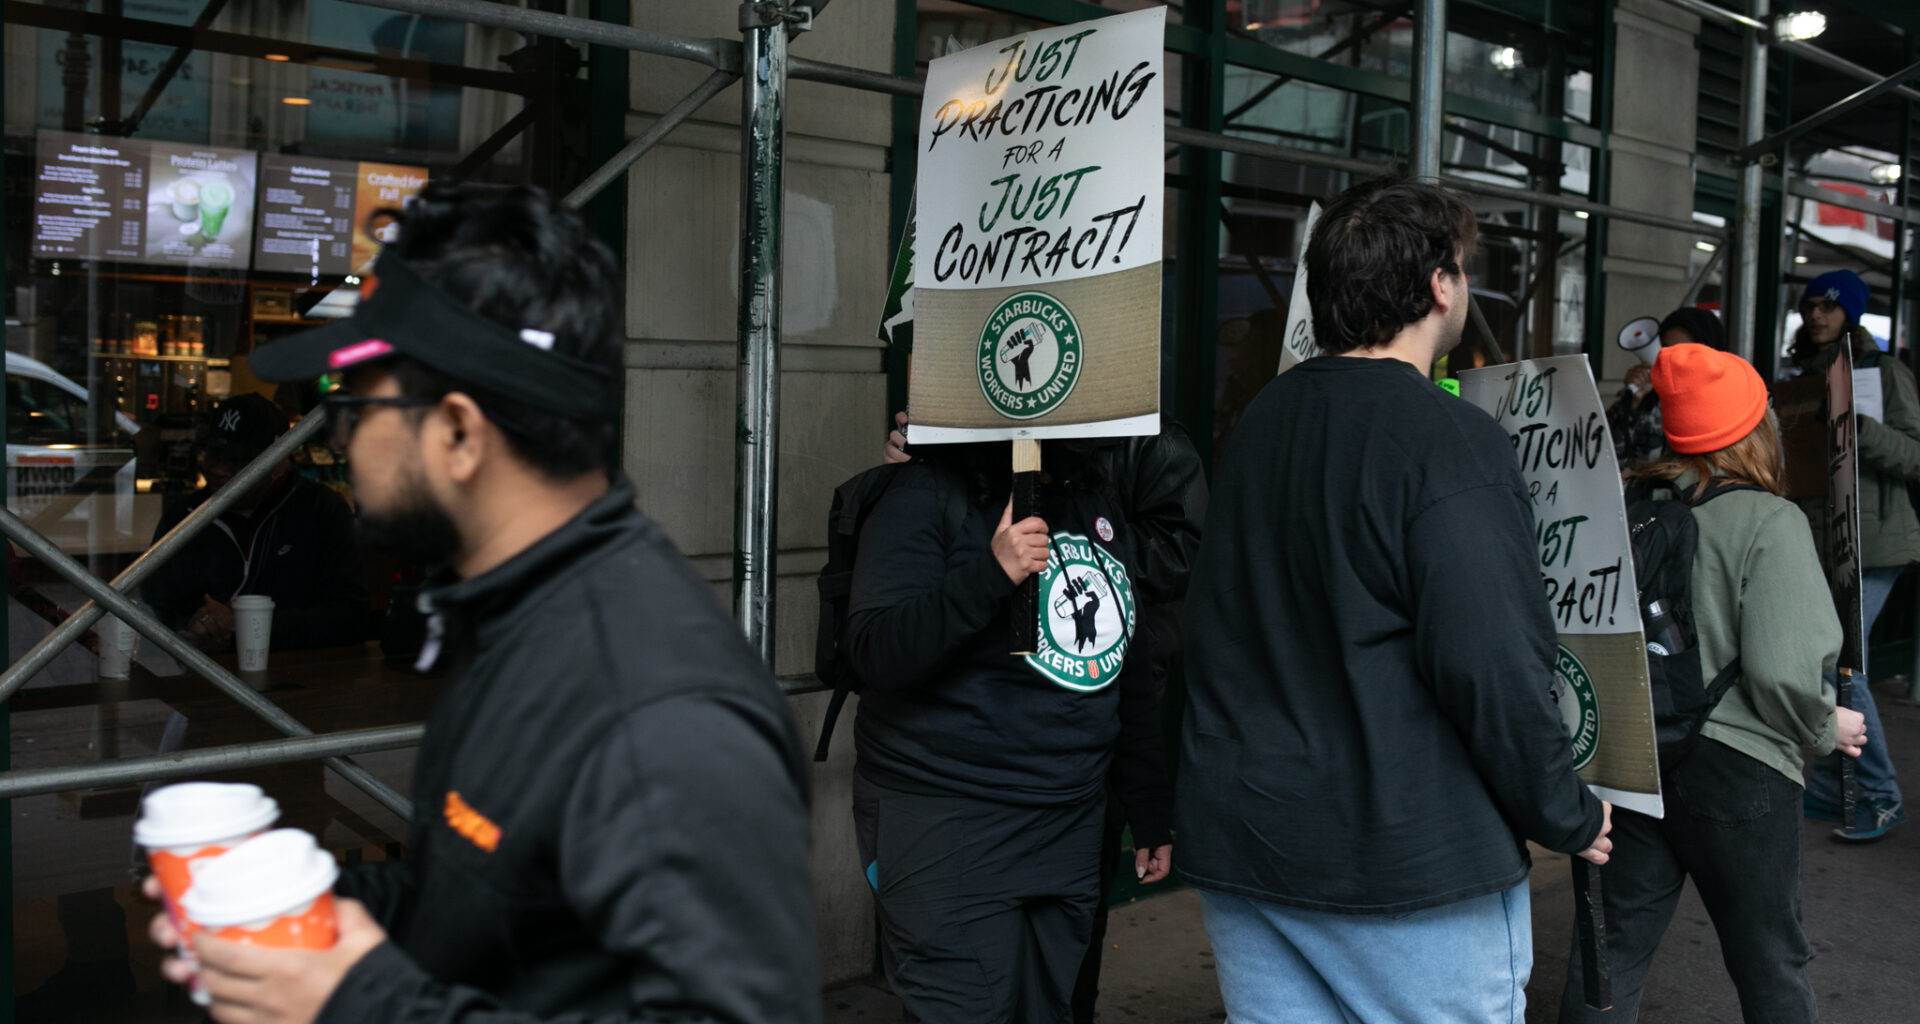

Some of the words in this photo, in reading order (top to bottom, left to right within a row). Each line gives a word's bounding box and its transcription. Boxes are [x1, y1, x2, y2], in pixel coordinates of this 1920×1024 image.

[984, 28, 1098, 96] JUST
[928, 61, 1157, 152] PRACTICING
[170, 155, 206, 168] Protein
[208, 159, 237, 171] Lattes
[368, 172, 408, 188] Crafted
[408, 175, 424, 188] for
[1002, 140, 1044, 170] FOR
[1047, 137, 1066, 163] A
[380, 187, 399, 200] Fall
[978, 165, 1102, 233] JUST
[933, 194, 1146, 285] CONTRACT!
[991, 300, 1068, 335] STARBUCKS
[980, 354, 1023, 410] WORKERS
[1037, 350, 1076, 405] UNITED
[1495, 367, 1558, 422] JUST
[219, 408, 240, 432] NY
[1546, 480, 1559, 506] A
[1536, 515, 1589, 568] ST
[1037, 613, 1085, 677] ORKERS
